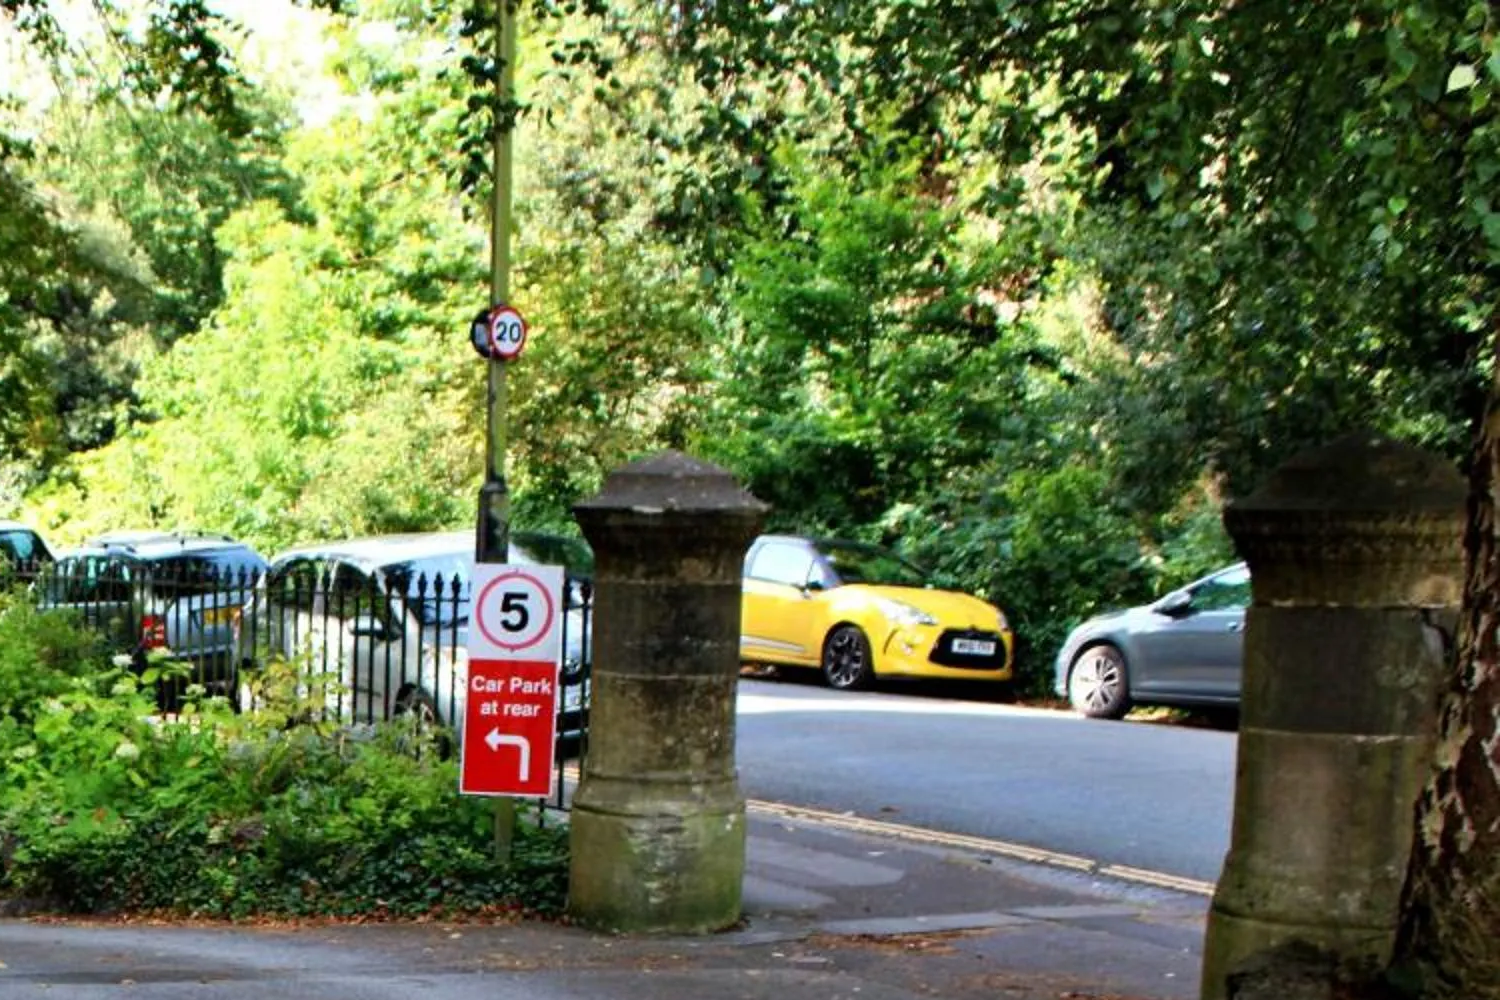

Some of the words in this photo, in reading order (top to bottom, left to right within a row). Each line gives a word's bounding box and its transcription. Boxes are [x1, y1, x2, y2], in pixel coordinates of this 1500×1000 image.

[496, 321, 521, 342] 20
[500, 592, 529, 632] 5
[471, 675, 505, 692] Car
[510, 676, 552, 694] Park
[481, 700, 498, 715] at
[503, 703, 541, 717] rear
